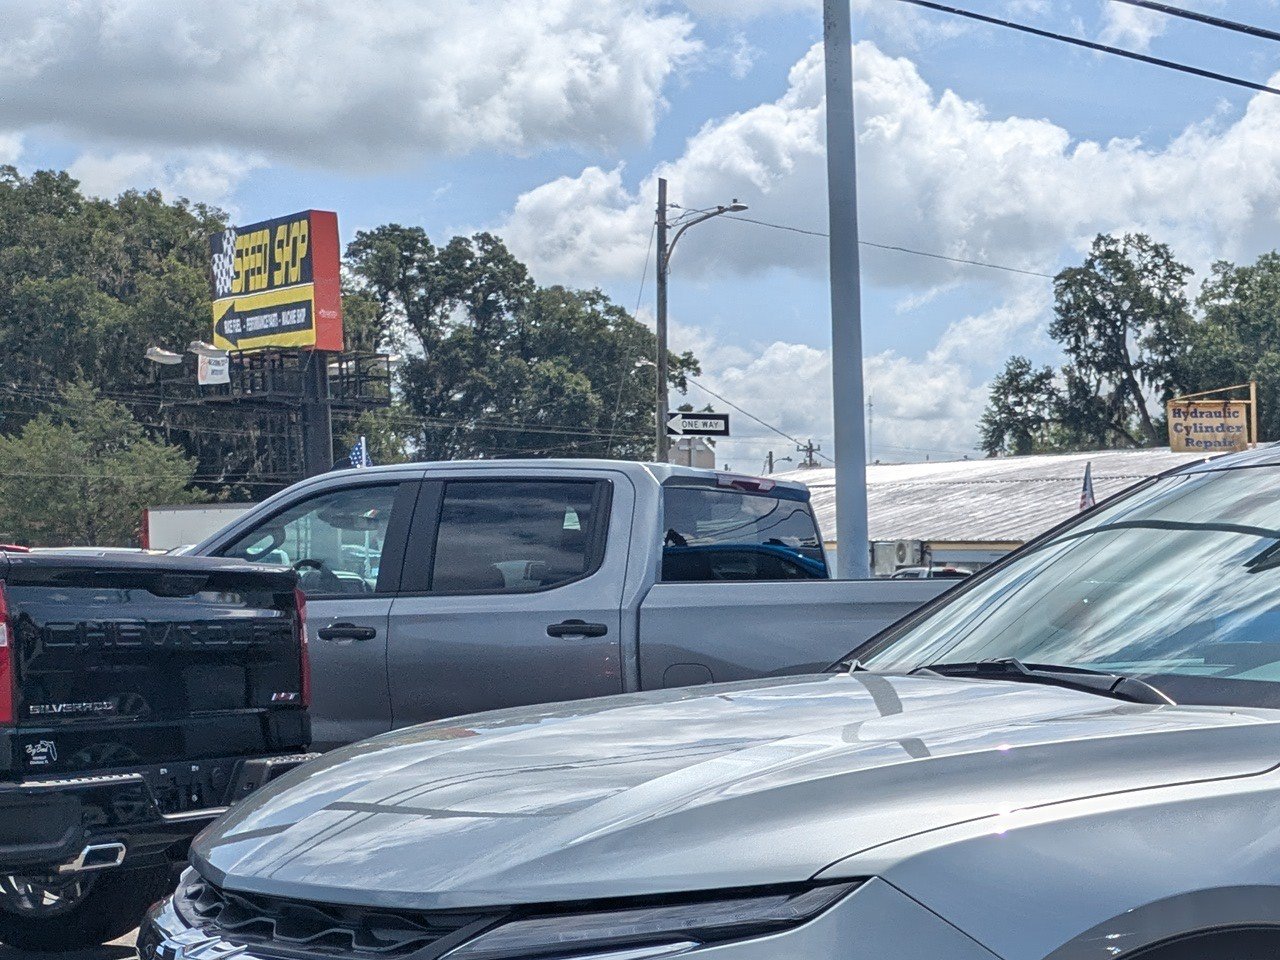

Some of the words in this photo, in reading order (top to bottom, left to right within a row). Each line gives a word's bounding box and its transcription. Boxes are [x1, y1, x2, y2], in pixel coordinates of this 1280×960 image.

[231, 229, 270, 293] SPEED
[274, 220, 308, 286] SHOP
[1172, 408, 1239, 421] Hydraulic
[682, 420, 699, 429] ONE
[702, 421, 718, 429] WAY
[1173, 422, 1243, 436] Cylinder
[1185, 438, 1236, 450] Repair
[29, 702, 114, 714] SILVERADO
